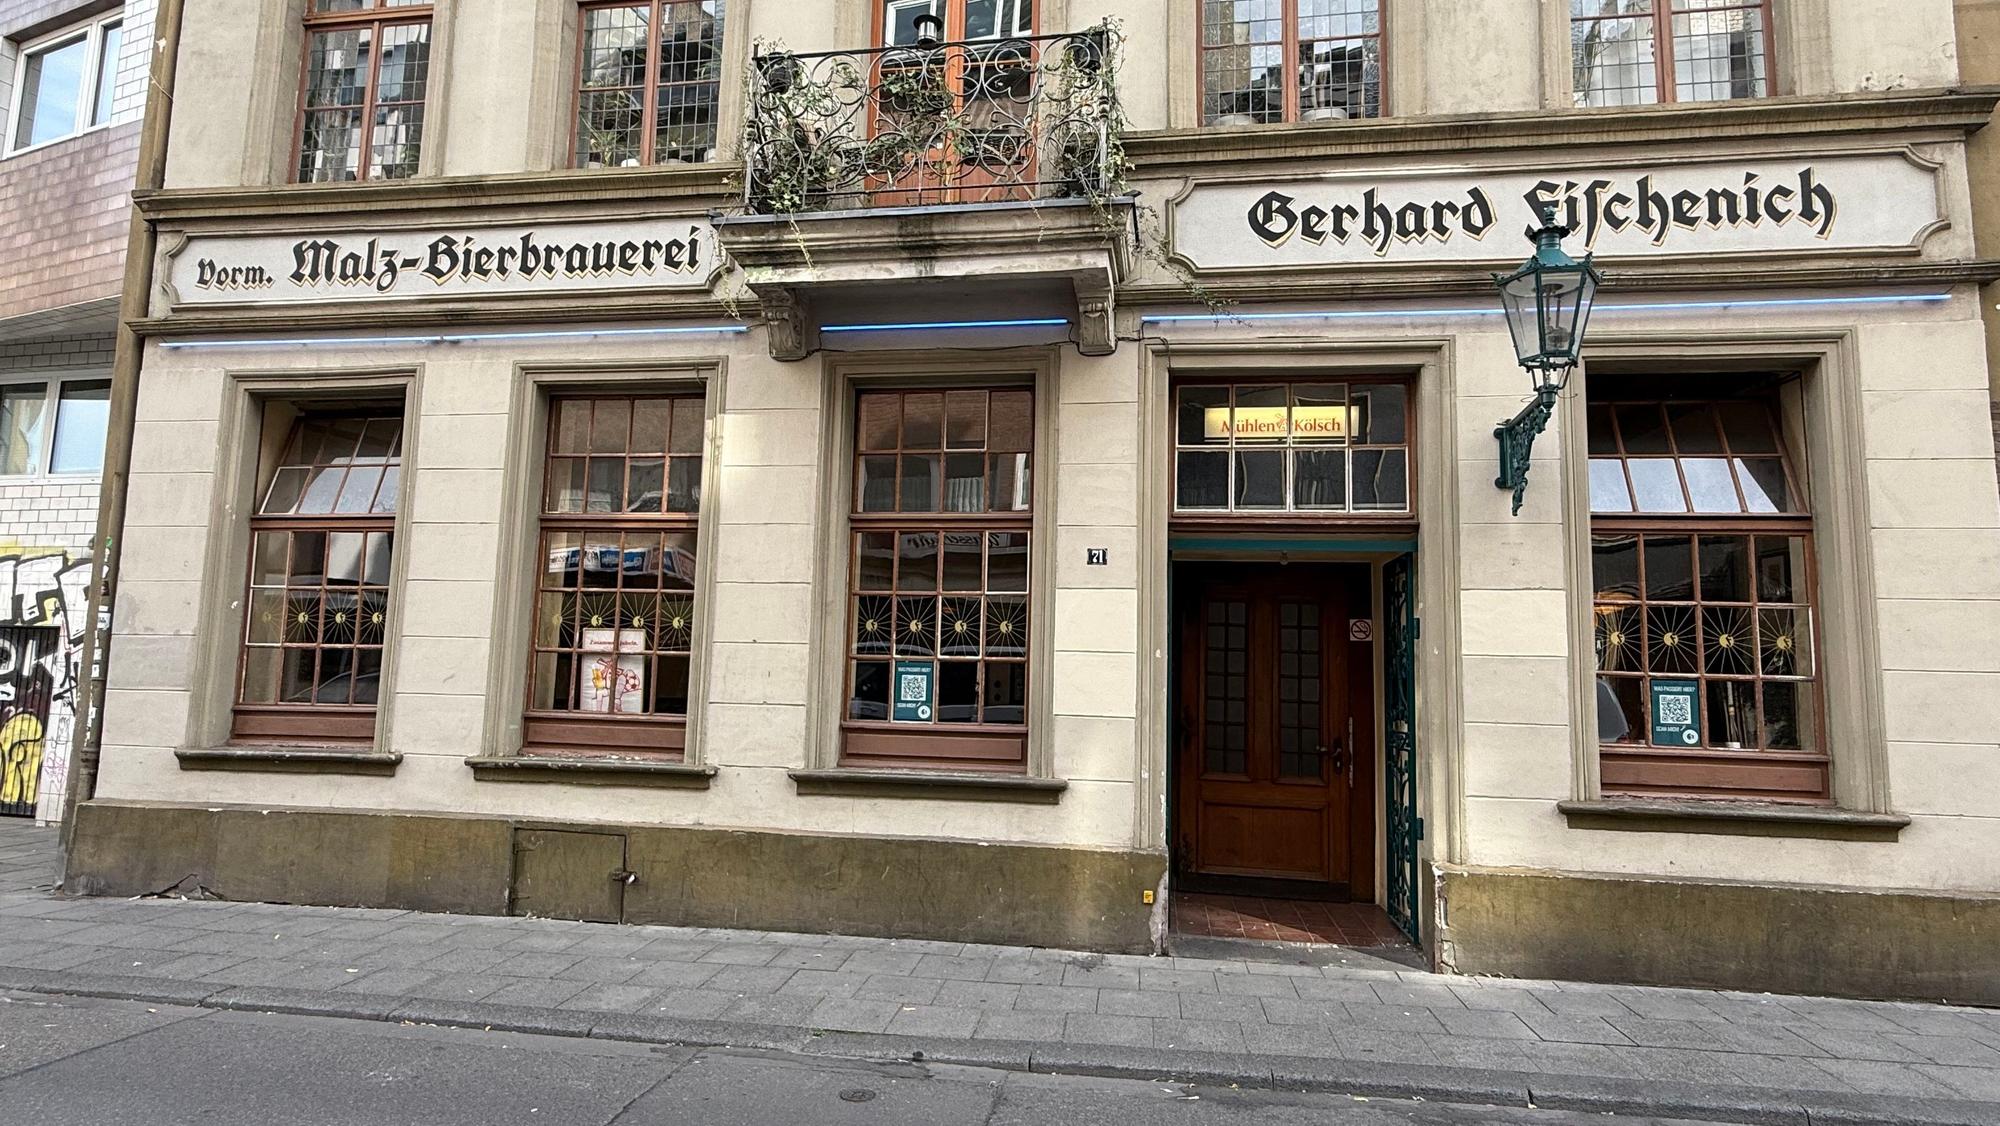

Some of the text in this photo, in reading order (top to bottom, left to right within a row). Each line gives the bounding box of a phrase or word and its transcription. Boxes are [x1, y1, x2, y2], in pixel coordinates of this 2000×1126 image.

[1248, 184, 1498, 257] Gerhard
[196, 225, 702, 293] Vorm. Malz-Bierbrauerei
[1221, 418, 1341, 433] Mühlen Kölsch
[1091, 549, 1103, 563] 71
